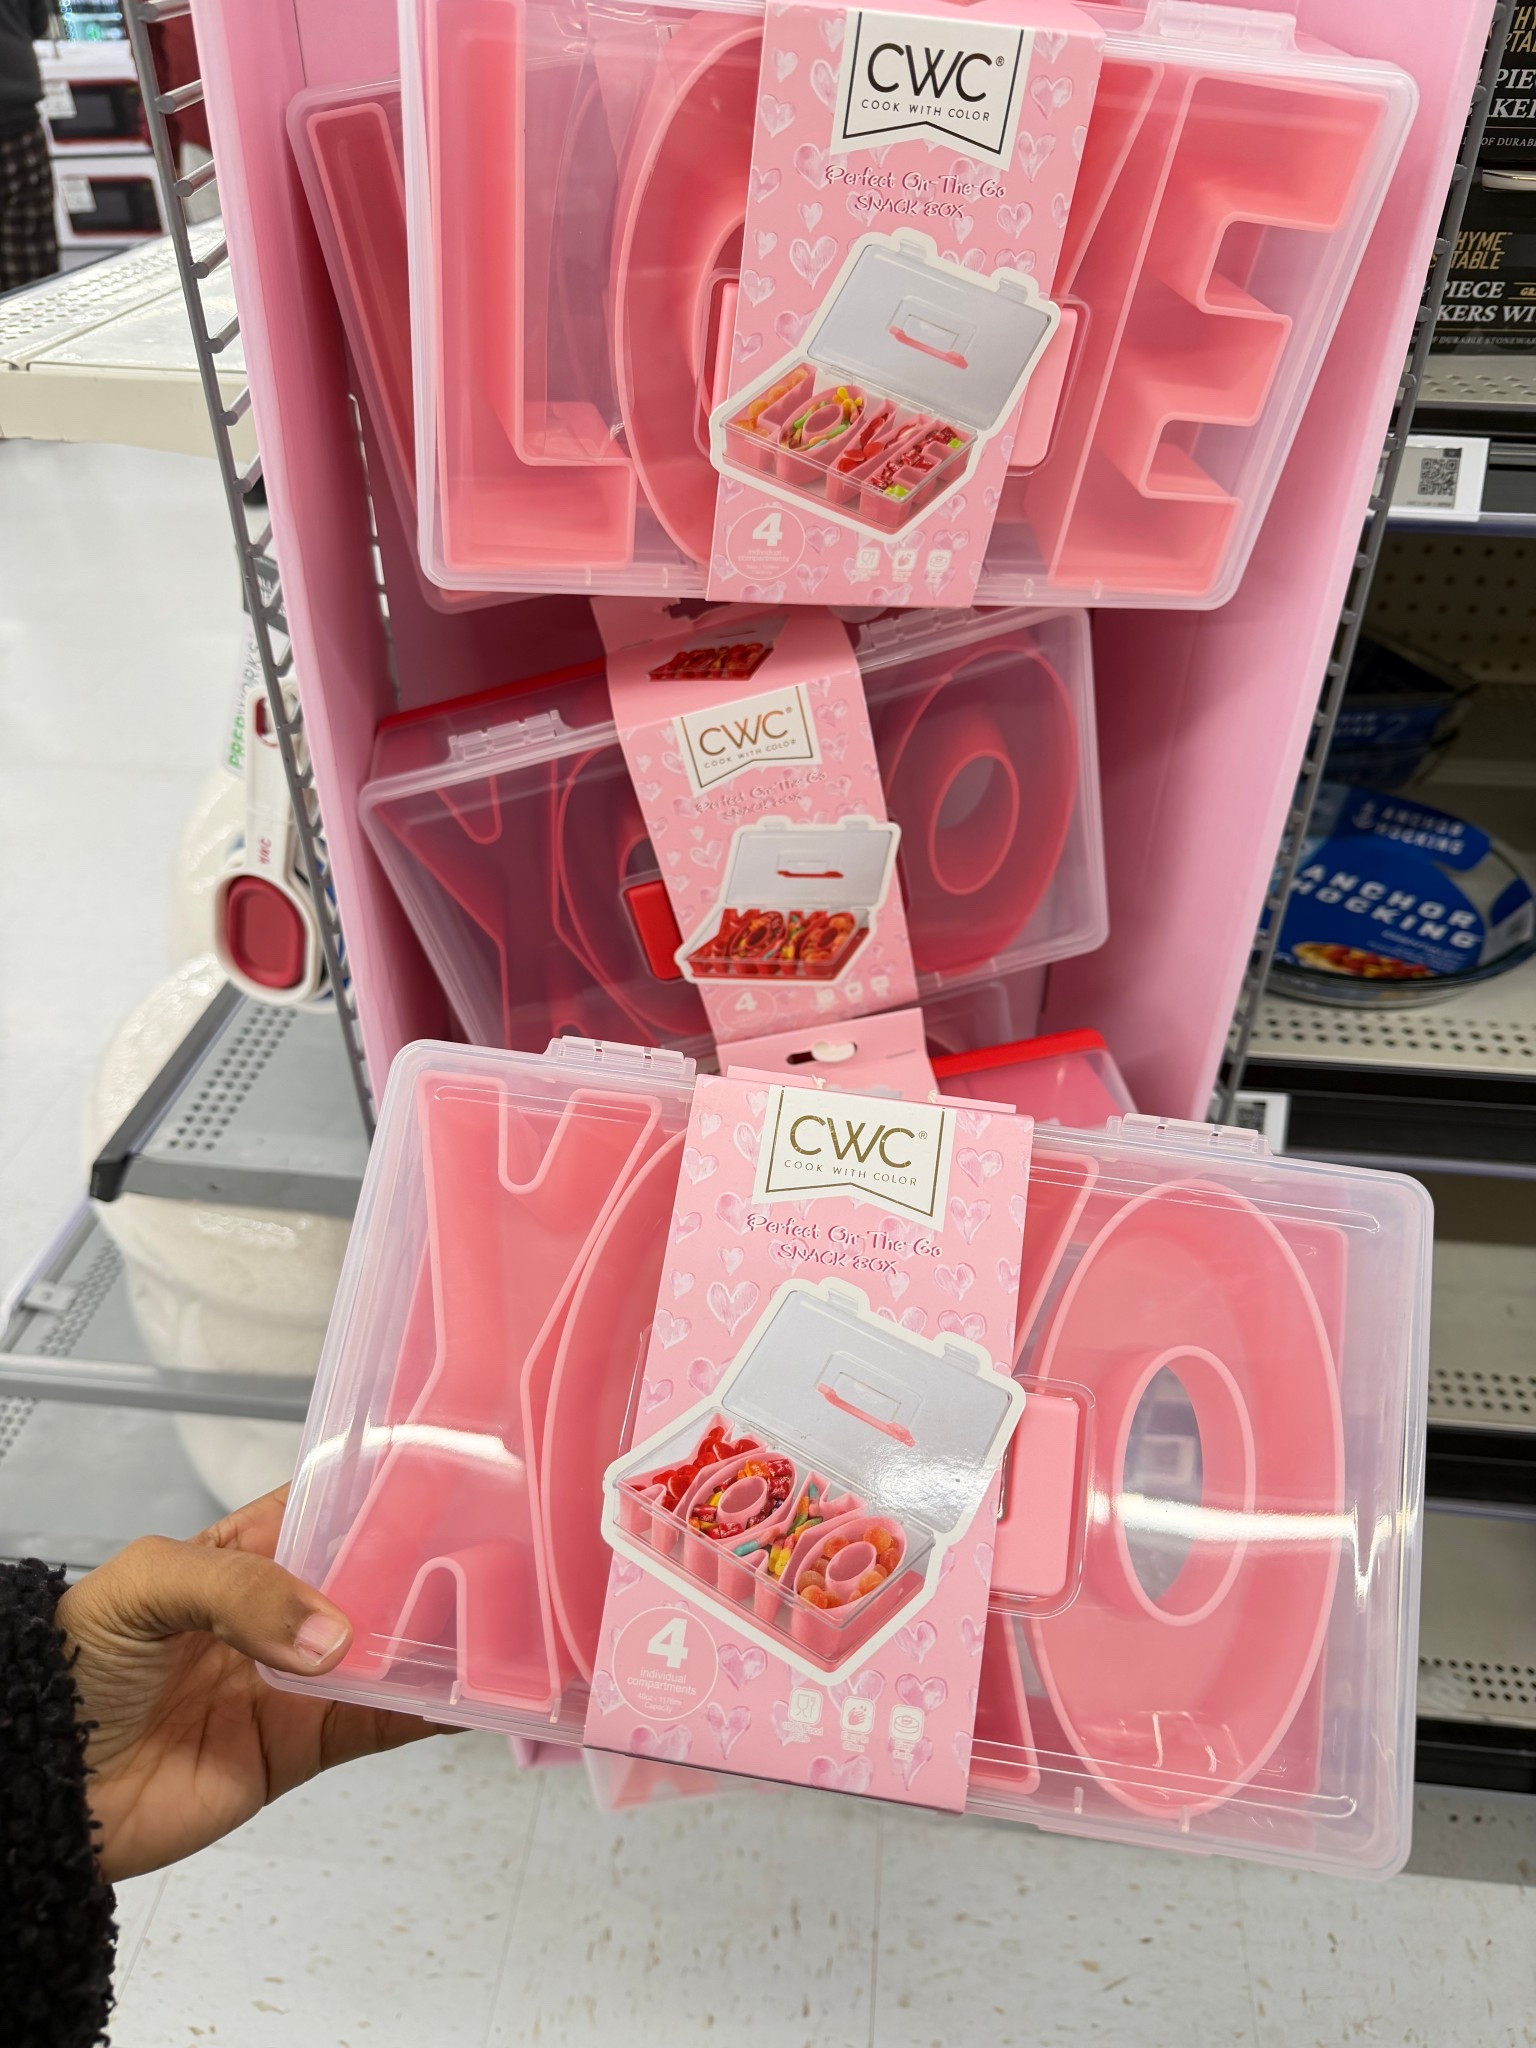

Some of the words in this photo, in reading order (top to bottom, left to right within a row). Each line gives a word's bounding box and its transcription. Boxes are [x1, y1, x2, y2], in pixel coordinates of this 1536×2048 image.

[1494, 69, 1536, 89] PIE
[861, 99, 900, 112] COOK
[909, 104, 942, 116] WITH
[948, 108, 990, 121] COLOR
[1496, 137, 1536, 147] DURAB
[825, 165, 896, 189] Perfect
[854, 195, 919, 215] SNACK
[923, 202, 966, 218] BOX
[1456, 231, 1507, 251] HYME
[1450, 251, 1505, 269] TABLE
[1437, 304, 1499, 322] KERS
[1502, 305, 1536, 322] WI
[752, 512, 784, 547] 4
[704, 757, 732, 769] COOK
[738, 748, 762, 760] WITH
[766, 739, 797, 752] COLOR
[1302, 864, 1478, 929] ANCHOR
[734, 992, 758, 1011] 4
[784, 1159, 823, 1172] COOK
[833, 1166, 867, 1179] WITH
[873, 1172, 917, 1186] COLOR
[747, 1213, 820, 1239] Perfect
[777, 1243, 846, 1267] SNACK
[852, 1255, 898, 1275] BOX
[647, 1617, 689, 1669] 4
[626, 1677, 697, 1696] compartments
[640, 1667, 687, 1684] individual
